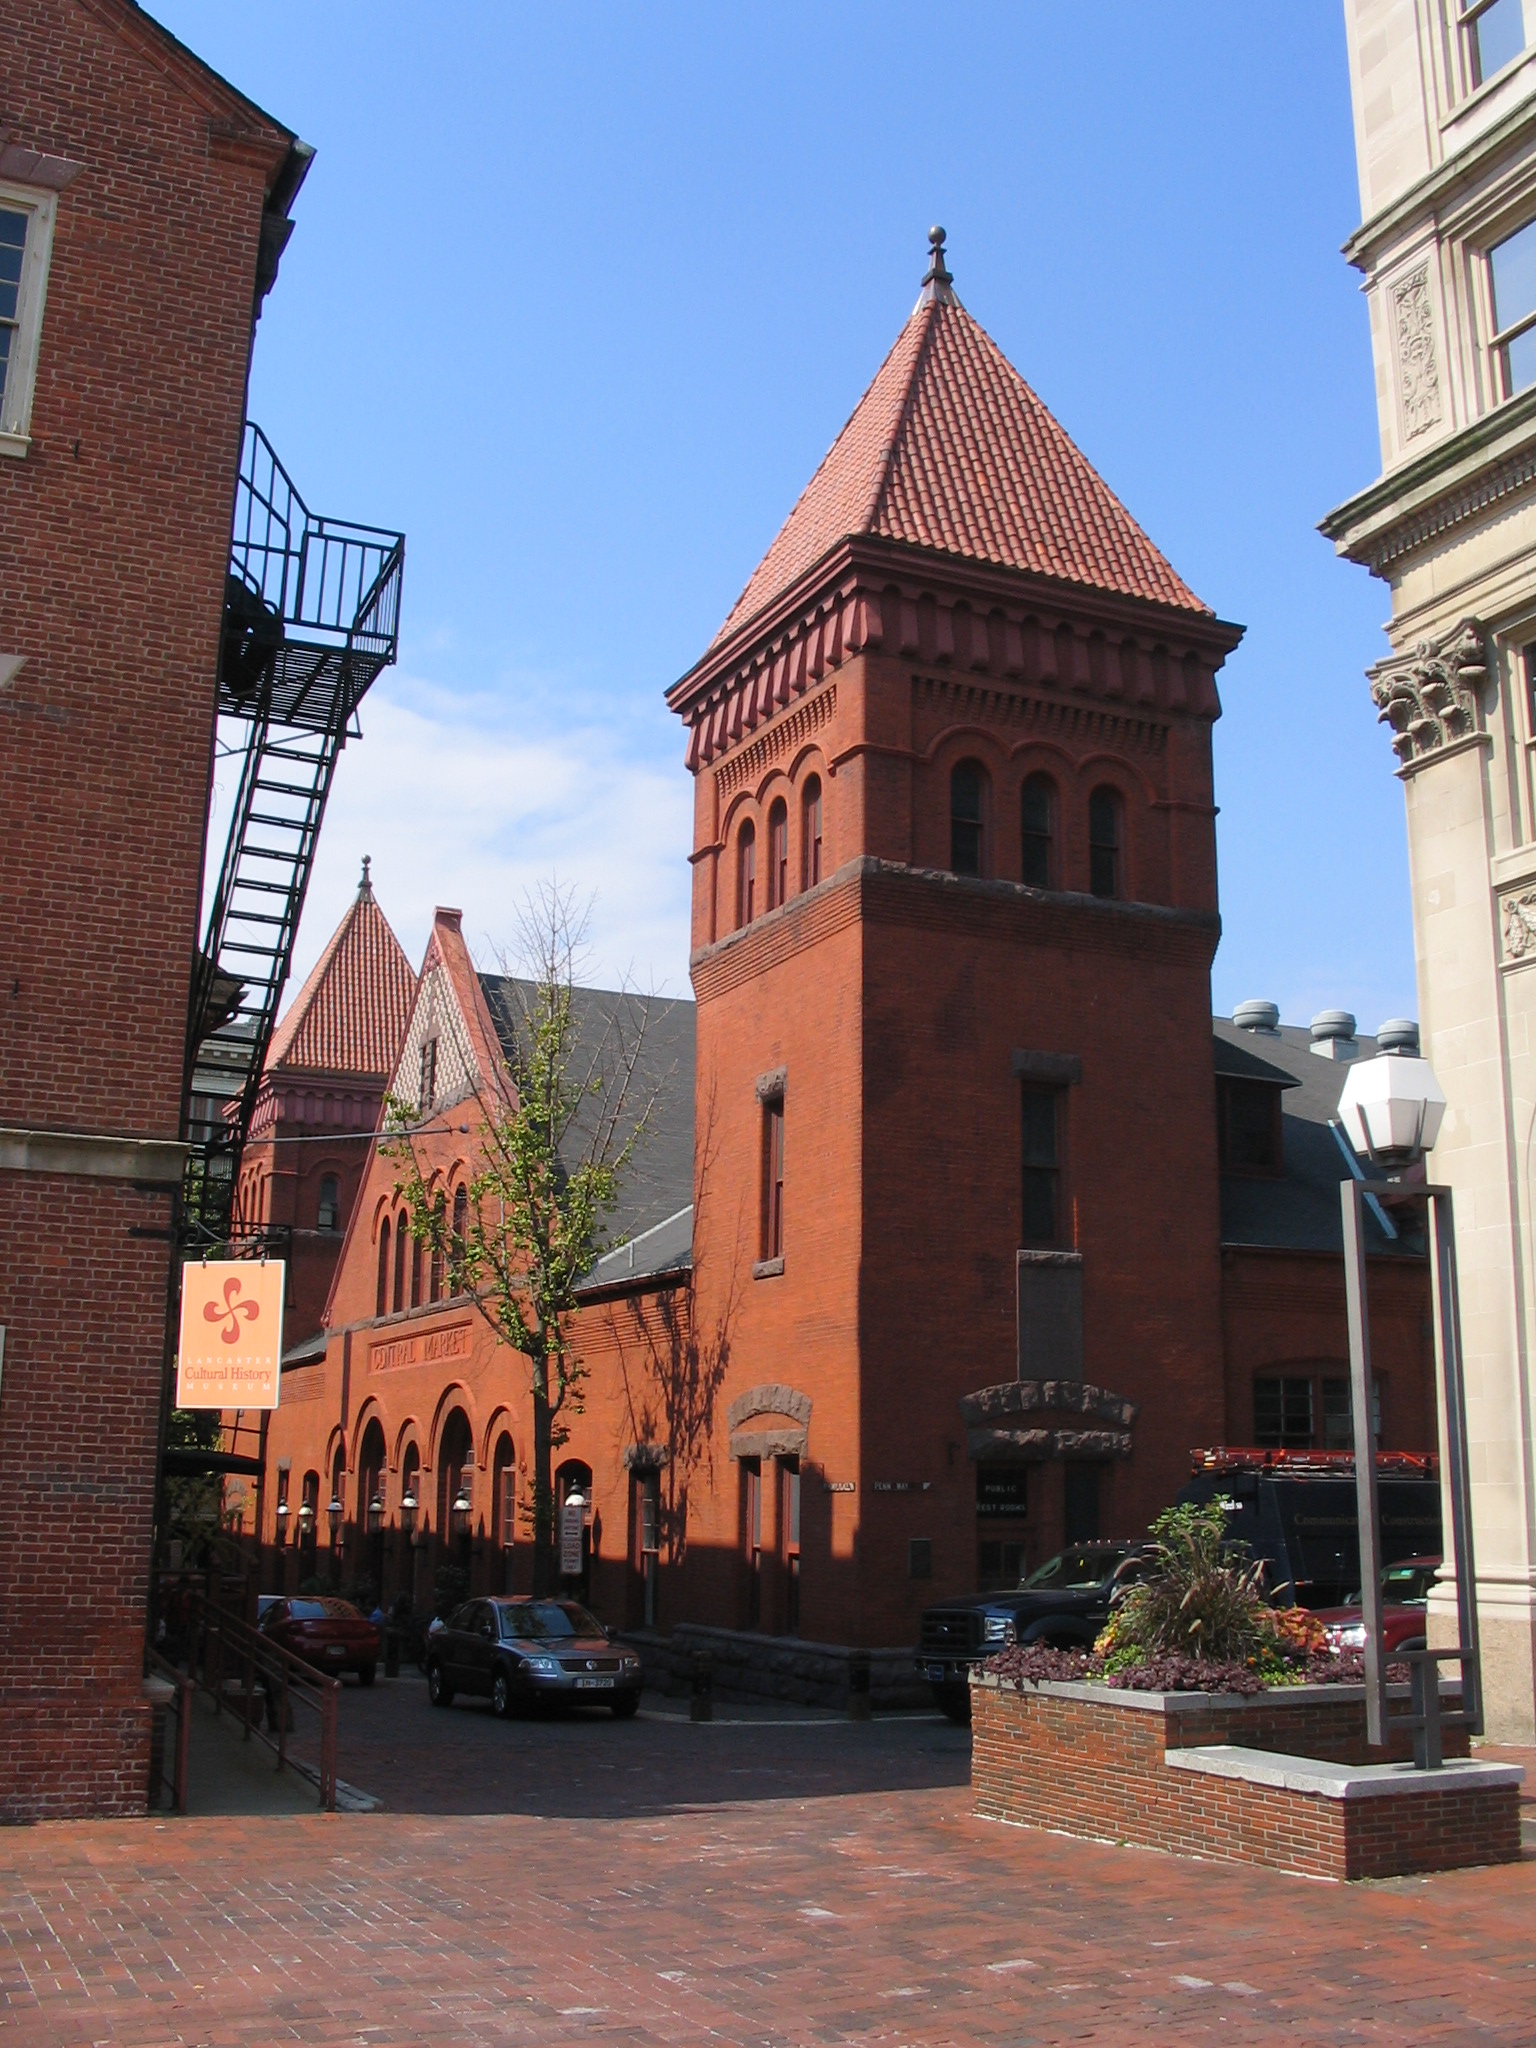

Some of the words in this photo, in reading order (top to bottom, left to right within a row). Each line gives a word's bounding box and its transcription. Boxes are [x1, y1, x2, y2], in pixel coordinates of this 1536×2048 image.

[425, 1329, 467, 1360] MARKET
[185, 1367, 227, 1379] Cultural
[231, 1367, 271, 1382] History
[186, 1382, 270, 1390] MUSEUM
[985, 1484, 1017, 1493] PUBLIC
[1294, 1513, 1359, 1525] Communica
